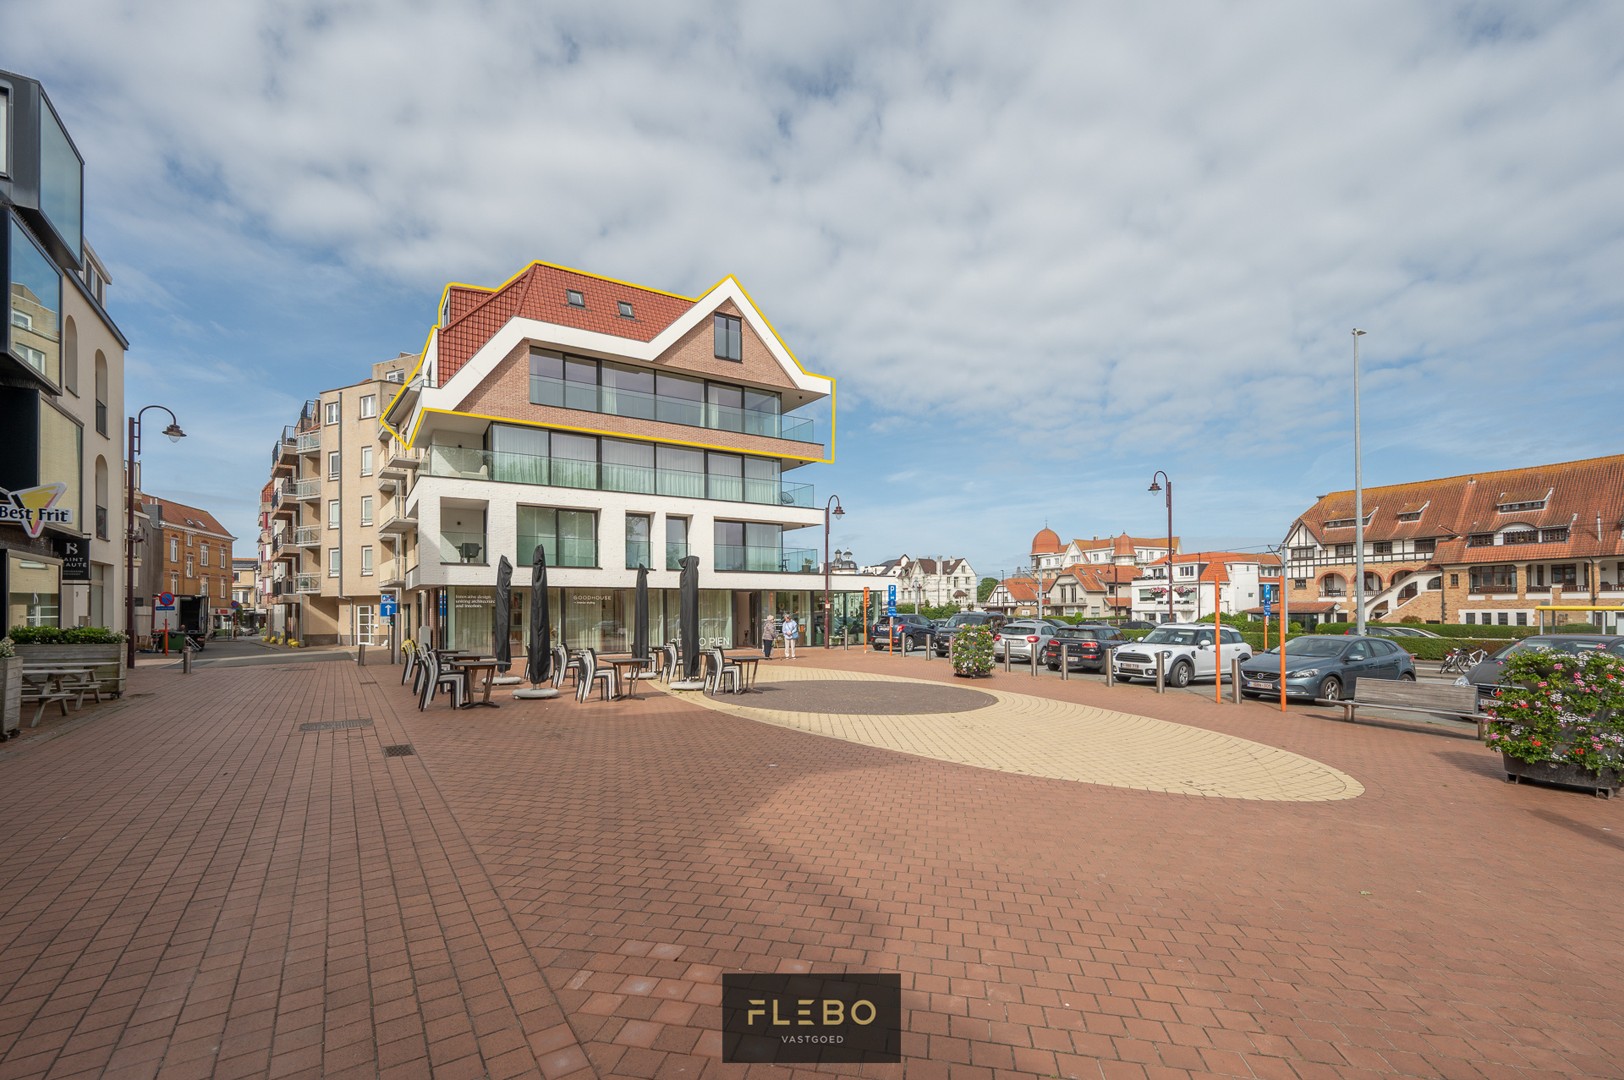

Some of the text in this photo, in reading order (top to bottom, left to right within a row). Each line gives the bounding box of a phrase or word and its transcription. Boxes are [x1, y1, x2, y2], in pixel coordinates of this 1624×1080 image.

[0, 506, 68, 522] Best Frit
[709, 636, 730, 646] PIEN
